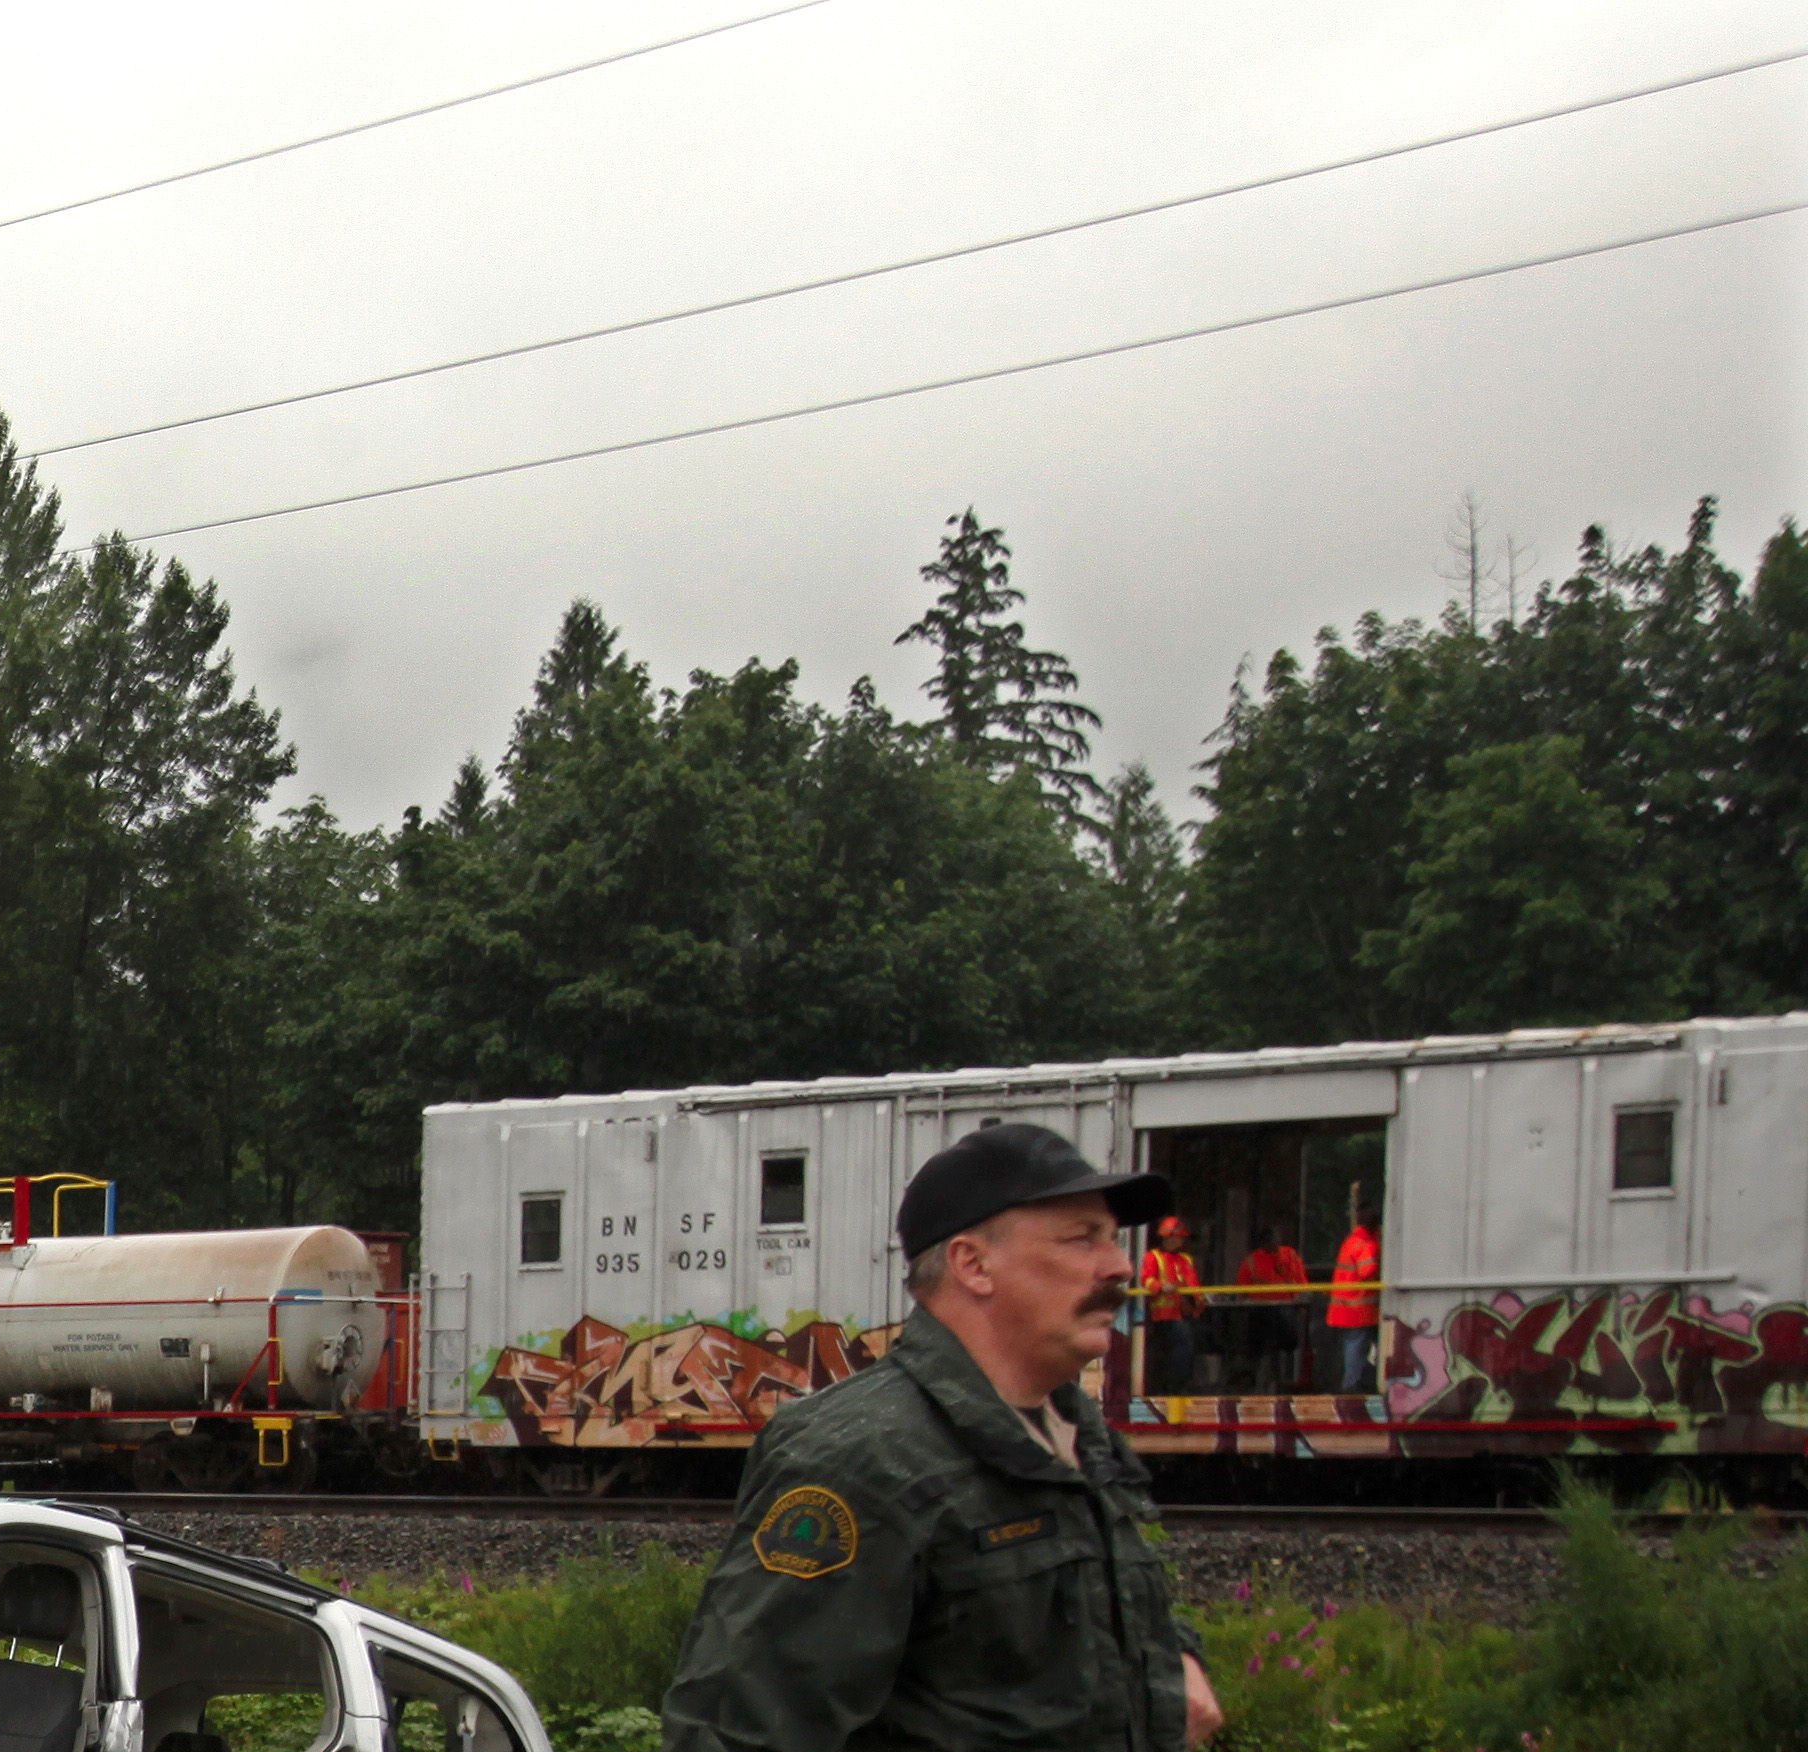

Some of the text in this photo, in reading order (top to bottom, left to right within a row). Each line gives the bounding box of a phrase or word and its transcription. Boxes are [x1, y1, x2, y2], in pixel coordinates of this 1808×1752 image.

[787, 1238, 811, 1250] CAR
[595, 1249, 726, 1273] 935 029
[827, 1503, 852, 1552] COUNTY
